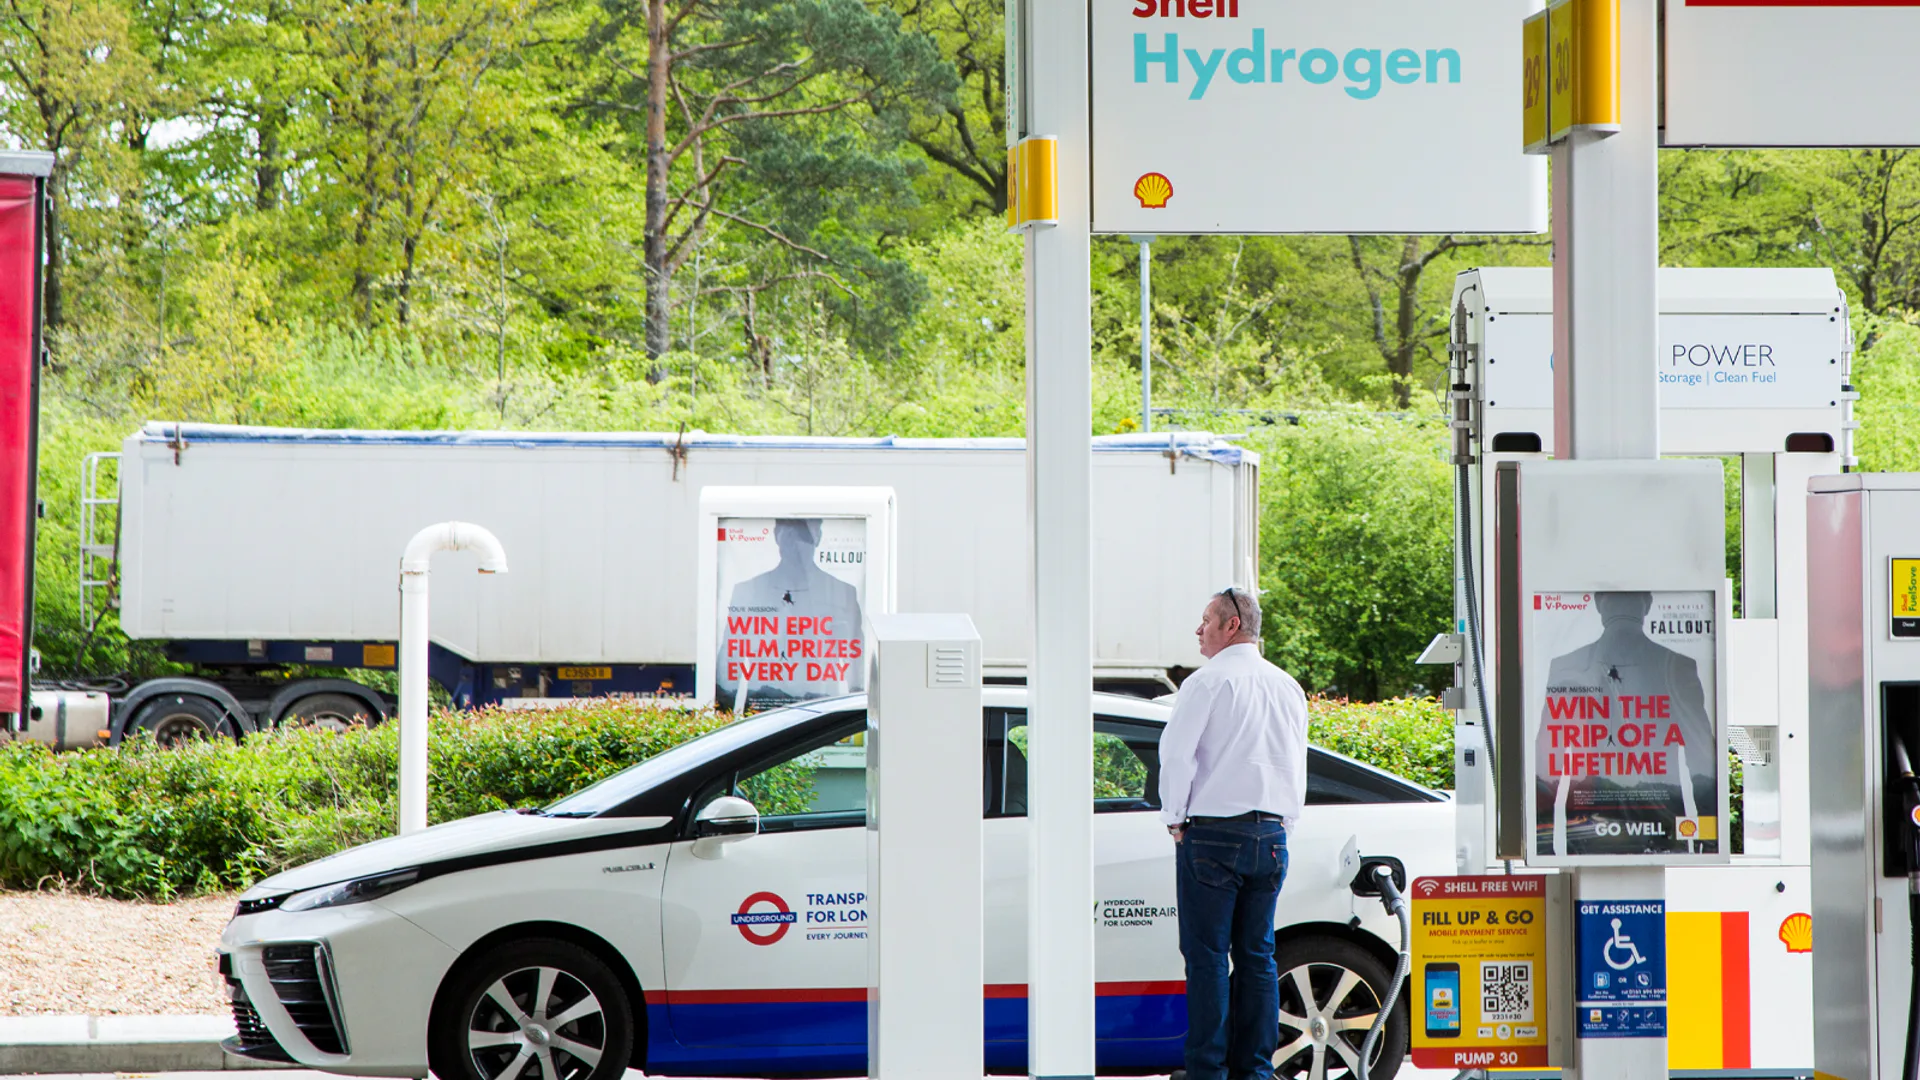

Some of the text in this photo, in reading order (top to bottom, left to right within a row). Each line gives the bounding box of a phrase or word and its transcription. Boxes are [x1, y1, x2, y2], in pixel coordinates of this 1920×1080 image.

[1133, 28, 1461, 100] Hydrogen
[1556, 37, 1570, 95] 30
[1525, 54, 1540, 109] 29
[1672, 344, 1776, 366] POWER
[1659, 371, 1776, 386] Storage Clean Fuel
[819, 551, 866, 564] FALLOU
[1908, 566, 1917, 612] FuelSave
[1545, 602, 1587, 610] V-Power
[727, 616, 833, 635] WIN EPIC
[1650, 620, 1712, 634] FALLOUT
[728, 639, 862, 658] FILM PRIZES
[728, 662, 850, 681] EVERY DAY
[1546, 695, 1670, 719] WIN THE
[1547, 723, 1686, 748] TRIP OF A
[1548, 752, 1667, 776] LIFETIME
[1595, 822, 1665, 837] GO WELL
[1444, 881, 1538, 893] SHELL FREE WIFI
[806, 892, 868, 905] TRANSP
[806, 911, 836, 923] FOR
[1580, 904, 1663, 915] GET ASSISTANCE
[733, 914, 794, 924] UNDERGROUND
[1120, 919, 1153, 927] LONDON
[1423, 909, 1534, 926] FILL UP & GO
[1429, 928, 1528, 937] MOBILE PAYMENT SERVICE
[1454, 1051, 1518, 1065] PUMP 30
